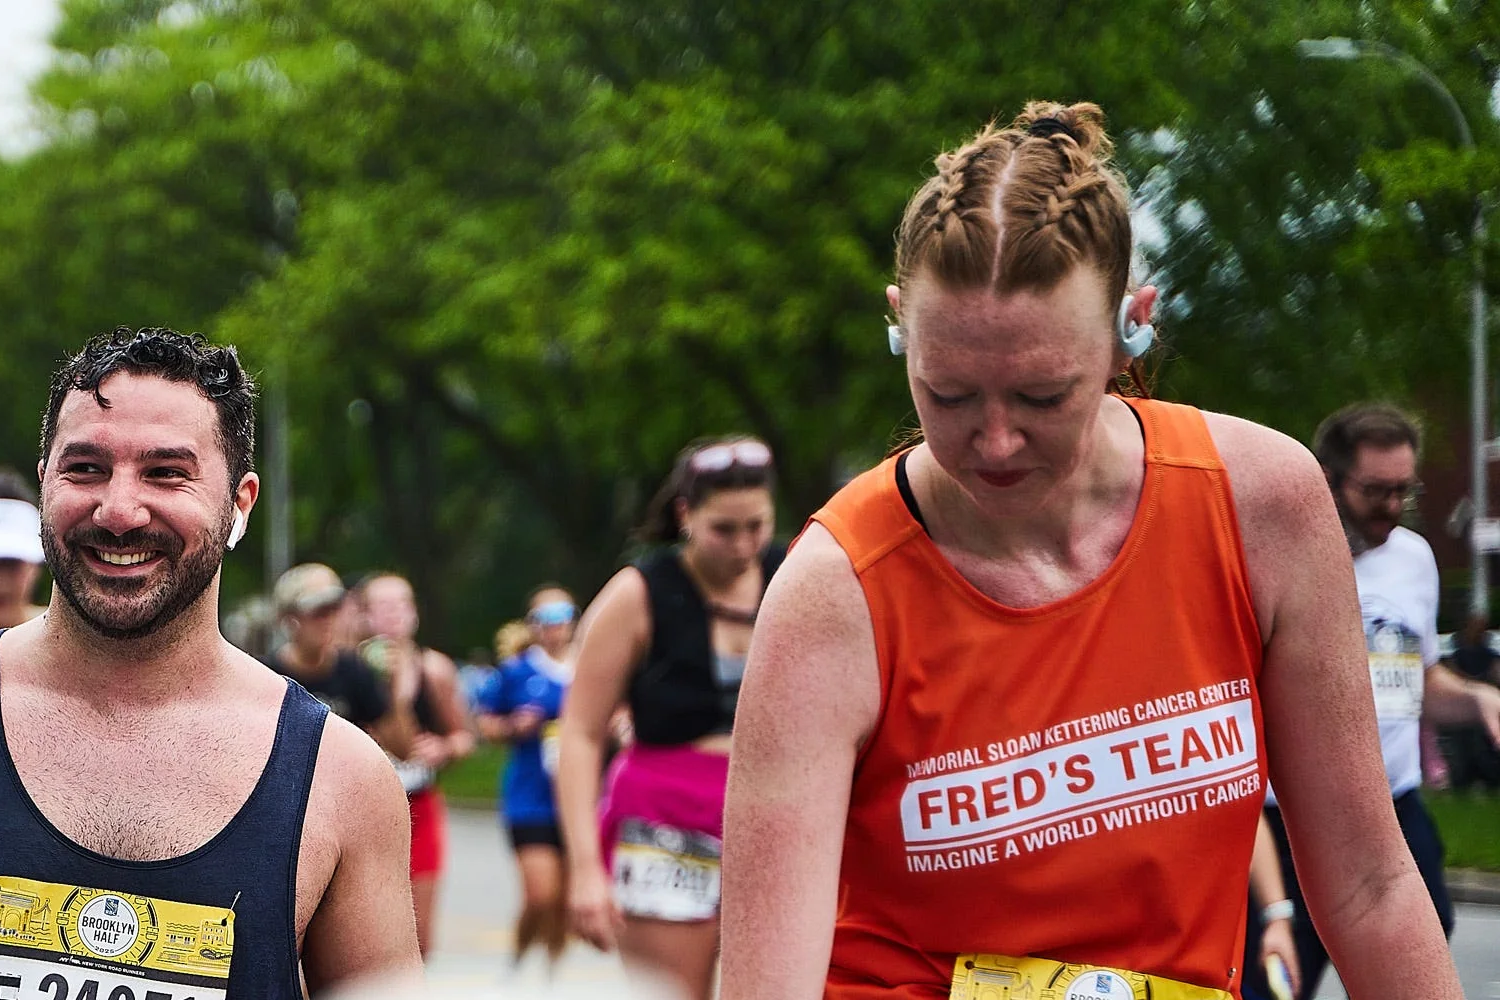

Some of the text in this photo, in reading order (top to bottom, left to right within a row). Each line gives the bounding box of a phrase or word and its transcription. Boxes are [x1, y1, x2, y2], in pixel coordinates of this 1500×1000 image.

[987, 731, 1041, 761] SLOAN
[1044, 707, 1131, 746] KETTERING
[1134, 690, 1197, 721] CANCER
[1199, 678, 1250, 706] CENTER
[1110, 715, 1245, 781] TEAM
[906, 773, 1261, 873] IMAGINE A WORLD WITHOUT CANCER
[81, 915, 135, 935] BROOKLYN
[93, 930, 120, 945] HALF
